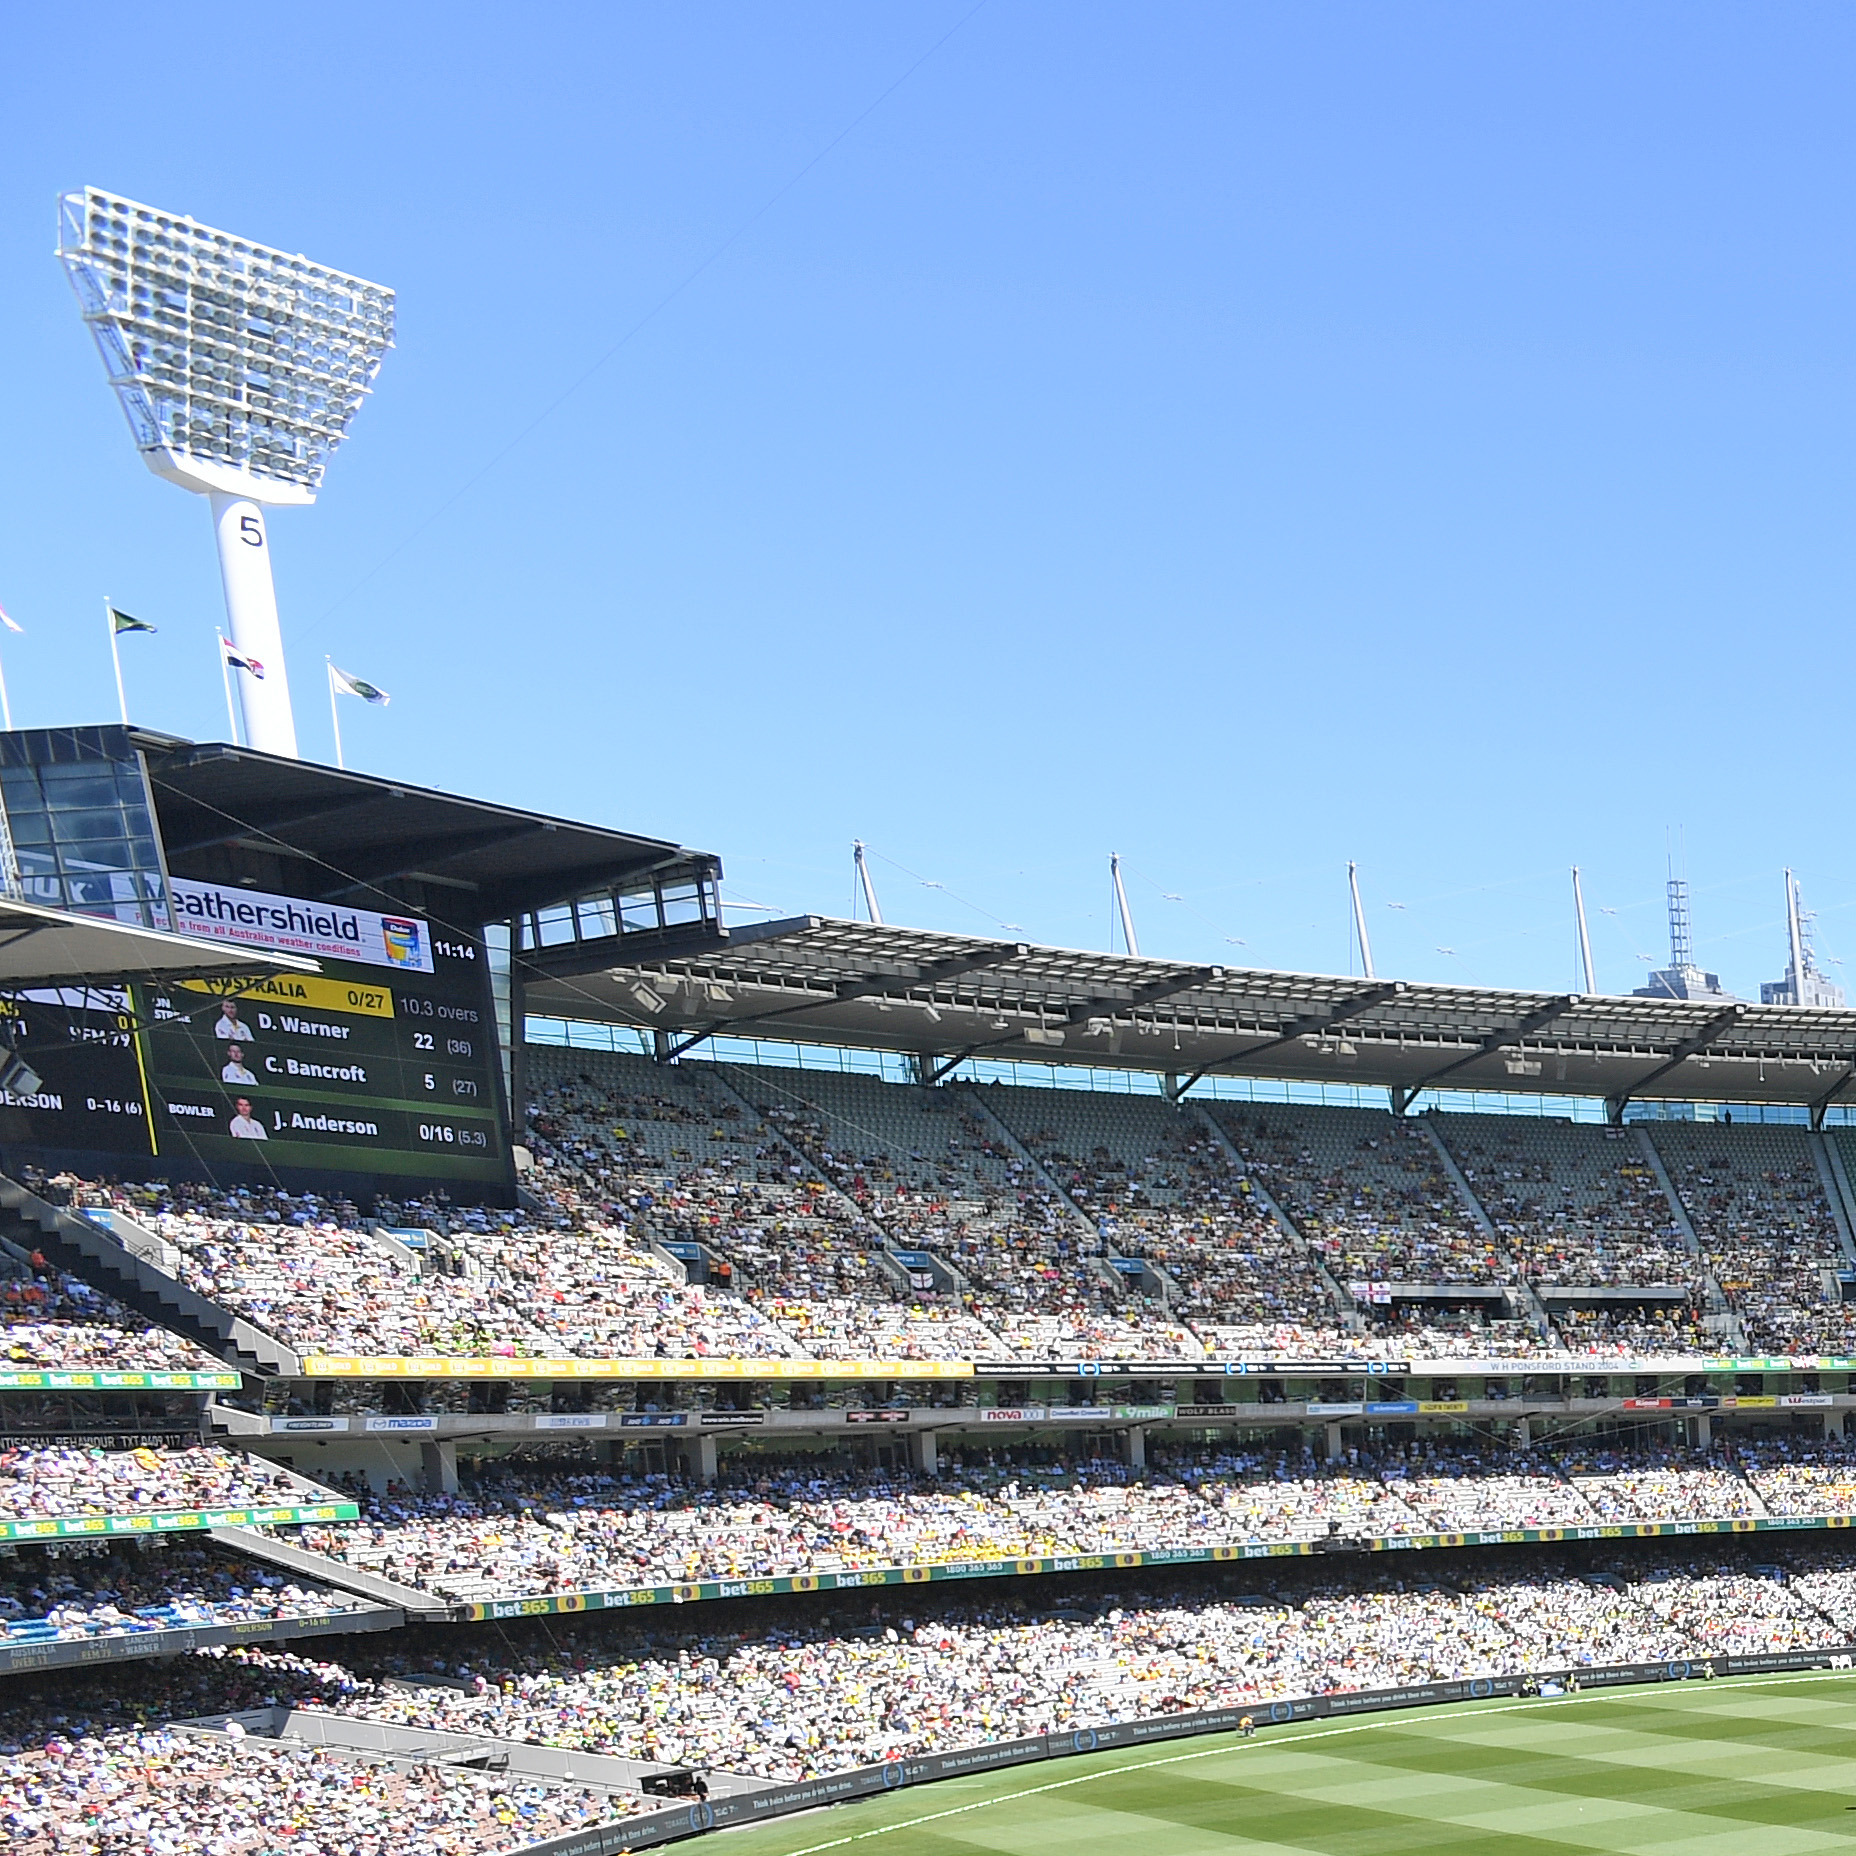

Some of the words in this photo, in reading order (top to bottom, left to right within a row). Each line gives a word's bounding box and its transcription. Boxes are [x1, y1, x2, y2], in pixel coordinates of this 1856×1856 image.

[240, 516, 263, 547] 5
[129, 875, 360, 941] Weathershield
[214, 923, 226, 935] all
[229, 927, 275, 943] Australian
[434, 940, 475, 960] 11:14
[347, 991, 385, 1010] 0/27
[401, 997, 433, 1017] 10.3
[438, 1005, 479, 1023] overs
[258, 1012, 277, 1031] D.
[281, 1016, 350, 1041] Warner
[413, 1032, 435, 1051] 22
[447, 1038, 473, 1058] (36)
[265, 1056, 283, 1074] C.
[288, 1059, 367, 1084] Bancroft
[424, 1074, 435, 1090] 5
[452, 1079, 478, 1097] (27)
[86, 1098, 121, 1114] 0-16
[125, 1100, 142, 1116] (6)
[168, 1103, 216, 1118] BOWLER
[274, 1111, 288, 1131] J.
[291, 1112, 378, 1136] Anderson
[419, 1123, 454, 1143] 0/16
[458, 1129, 488, 1147] (5.3)
[1491, 1362, 1499, 1371] W
[1500, 1362, 1507, 1371] H
[1509, 1362, 1562, 1371] PONSFORD
[1563, 1362, 1596, 1371] STAND
[1598, 1361, 1619, 1370] 2004
[1125, 1407, 1173, 1419] 9mile
[1178, 1407, 1206, 1416] WOLF
[1208, 1407, 1237, 1416] BLASS
[388, 1418, 432, 1430] mazda
[120, 1435, 139, 1446] TXT
[165, 1435, 181, 1446] 117
[1479, 1531, 1524, 1543] bet365
[1577, 1526, 1622, 1538] bet365
[1675, 1522, 1719, 1535] bet365
[1245, 1544, 1293, 1559] bet365
[1054, 1556, 1104, 1571] bet365
[720, 1580, 774, 1597] bet365
[836, 1572, 887, 1588] bet365
[603, 1589, 656, 1607] bet365
[493, 1600, 550, 1617] bet365
